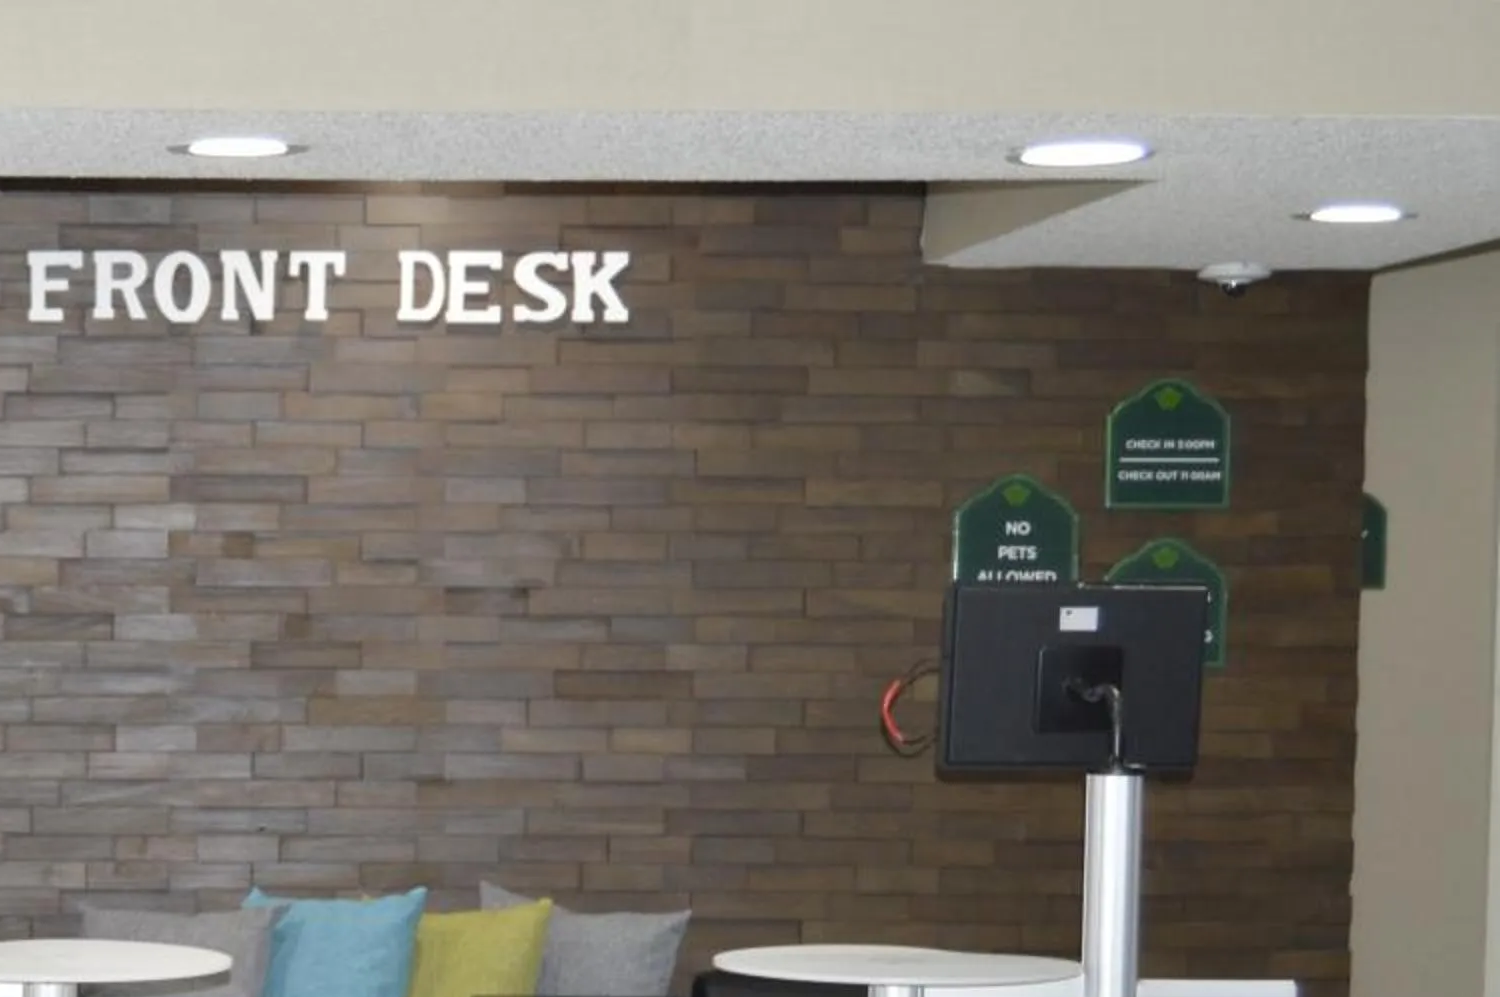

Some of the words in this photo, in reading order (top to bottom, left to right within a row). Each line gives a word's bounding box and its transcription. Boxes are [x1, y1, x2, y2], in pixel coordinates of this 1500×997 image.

[26, 249, 346, 324] FRONT
[396, 249, 630, 325] DESK
[1125, 438, 1161, 450] CHECK
[1163, 439, 1175, 450] IN
[1117, 470, 1154, 481] CHECK
[1155, 470, 1177, 481] OUT
[1005, 520, 1032, 536] NO
[997, 545, 1039, 561] PETS
